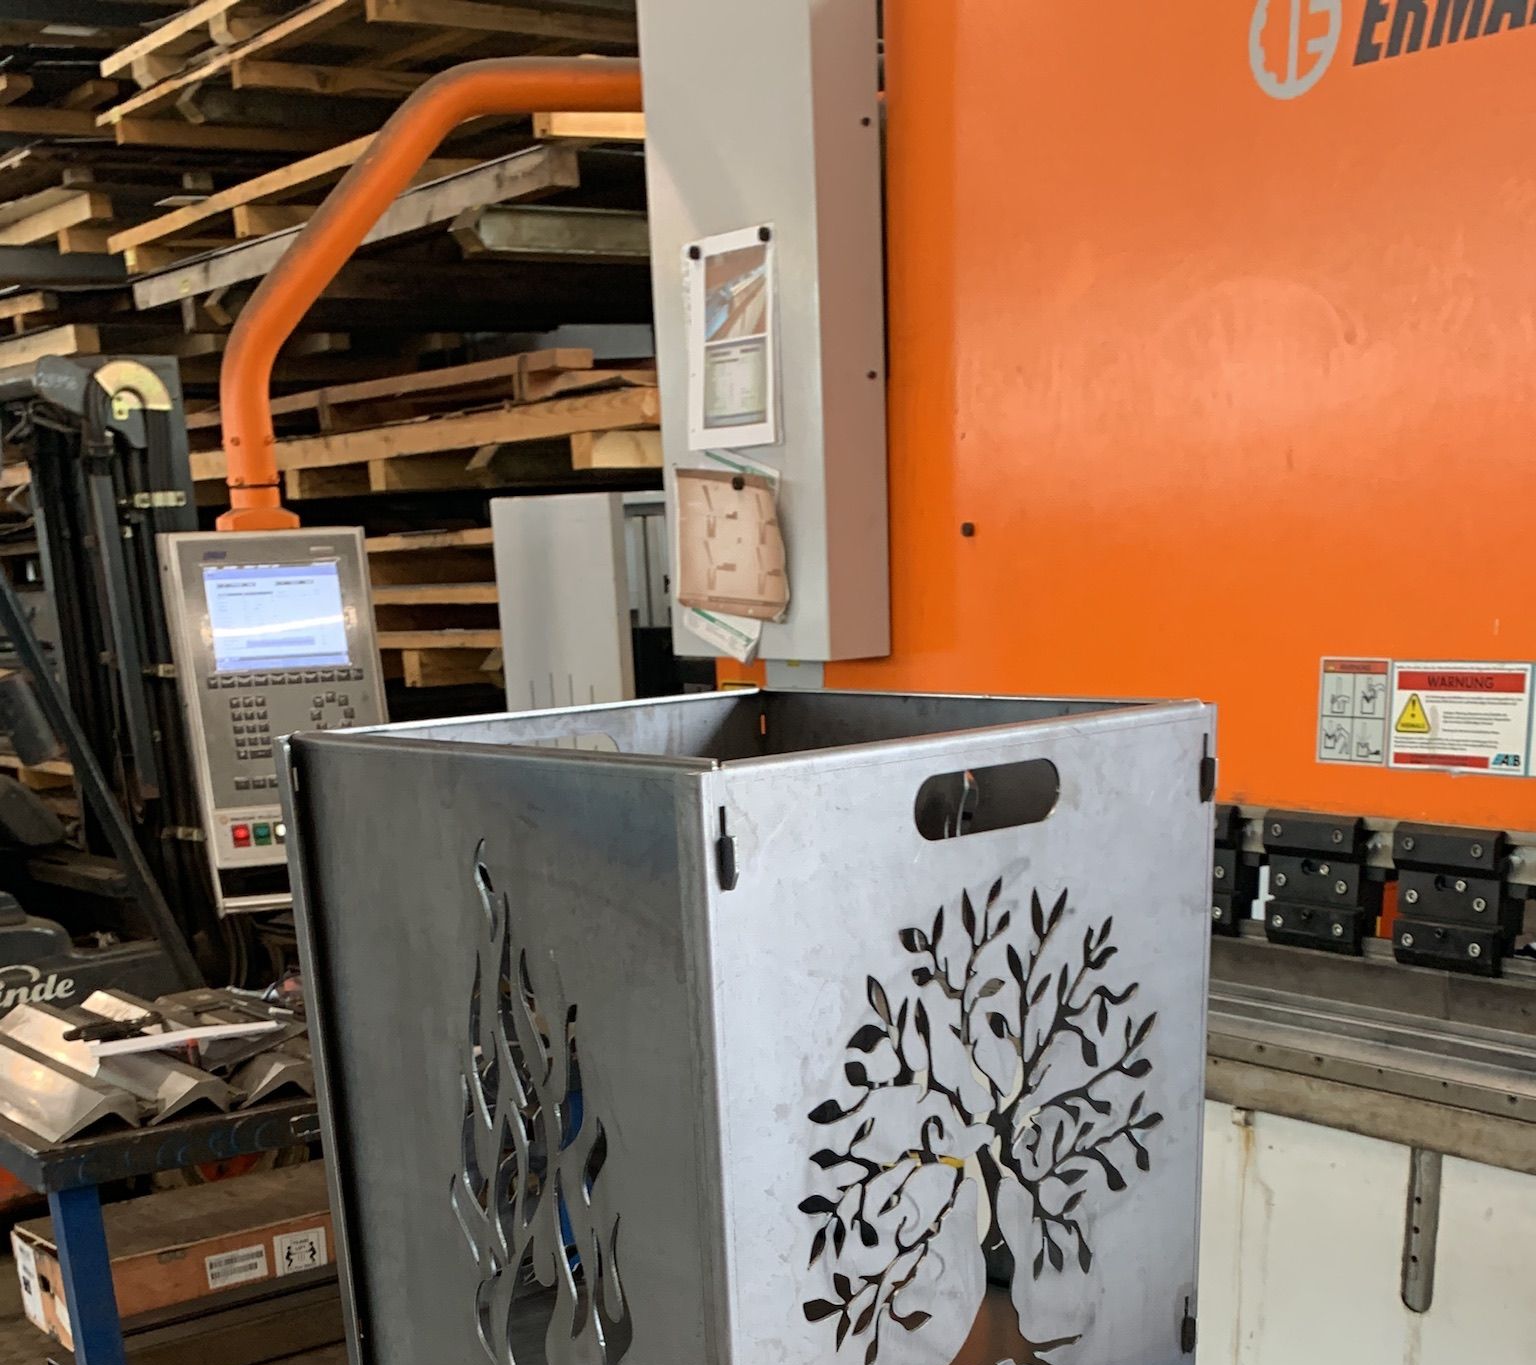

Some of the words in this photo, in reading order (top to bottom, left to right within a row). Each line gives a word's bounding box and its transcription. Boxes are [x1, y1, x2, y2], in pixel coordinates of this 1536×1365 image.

[1353, 0, 1536, 66] ERMA
[1427, 675, 1494, 689] WARNUNG
[0, 965, 76, 1008] inde
